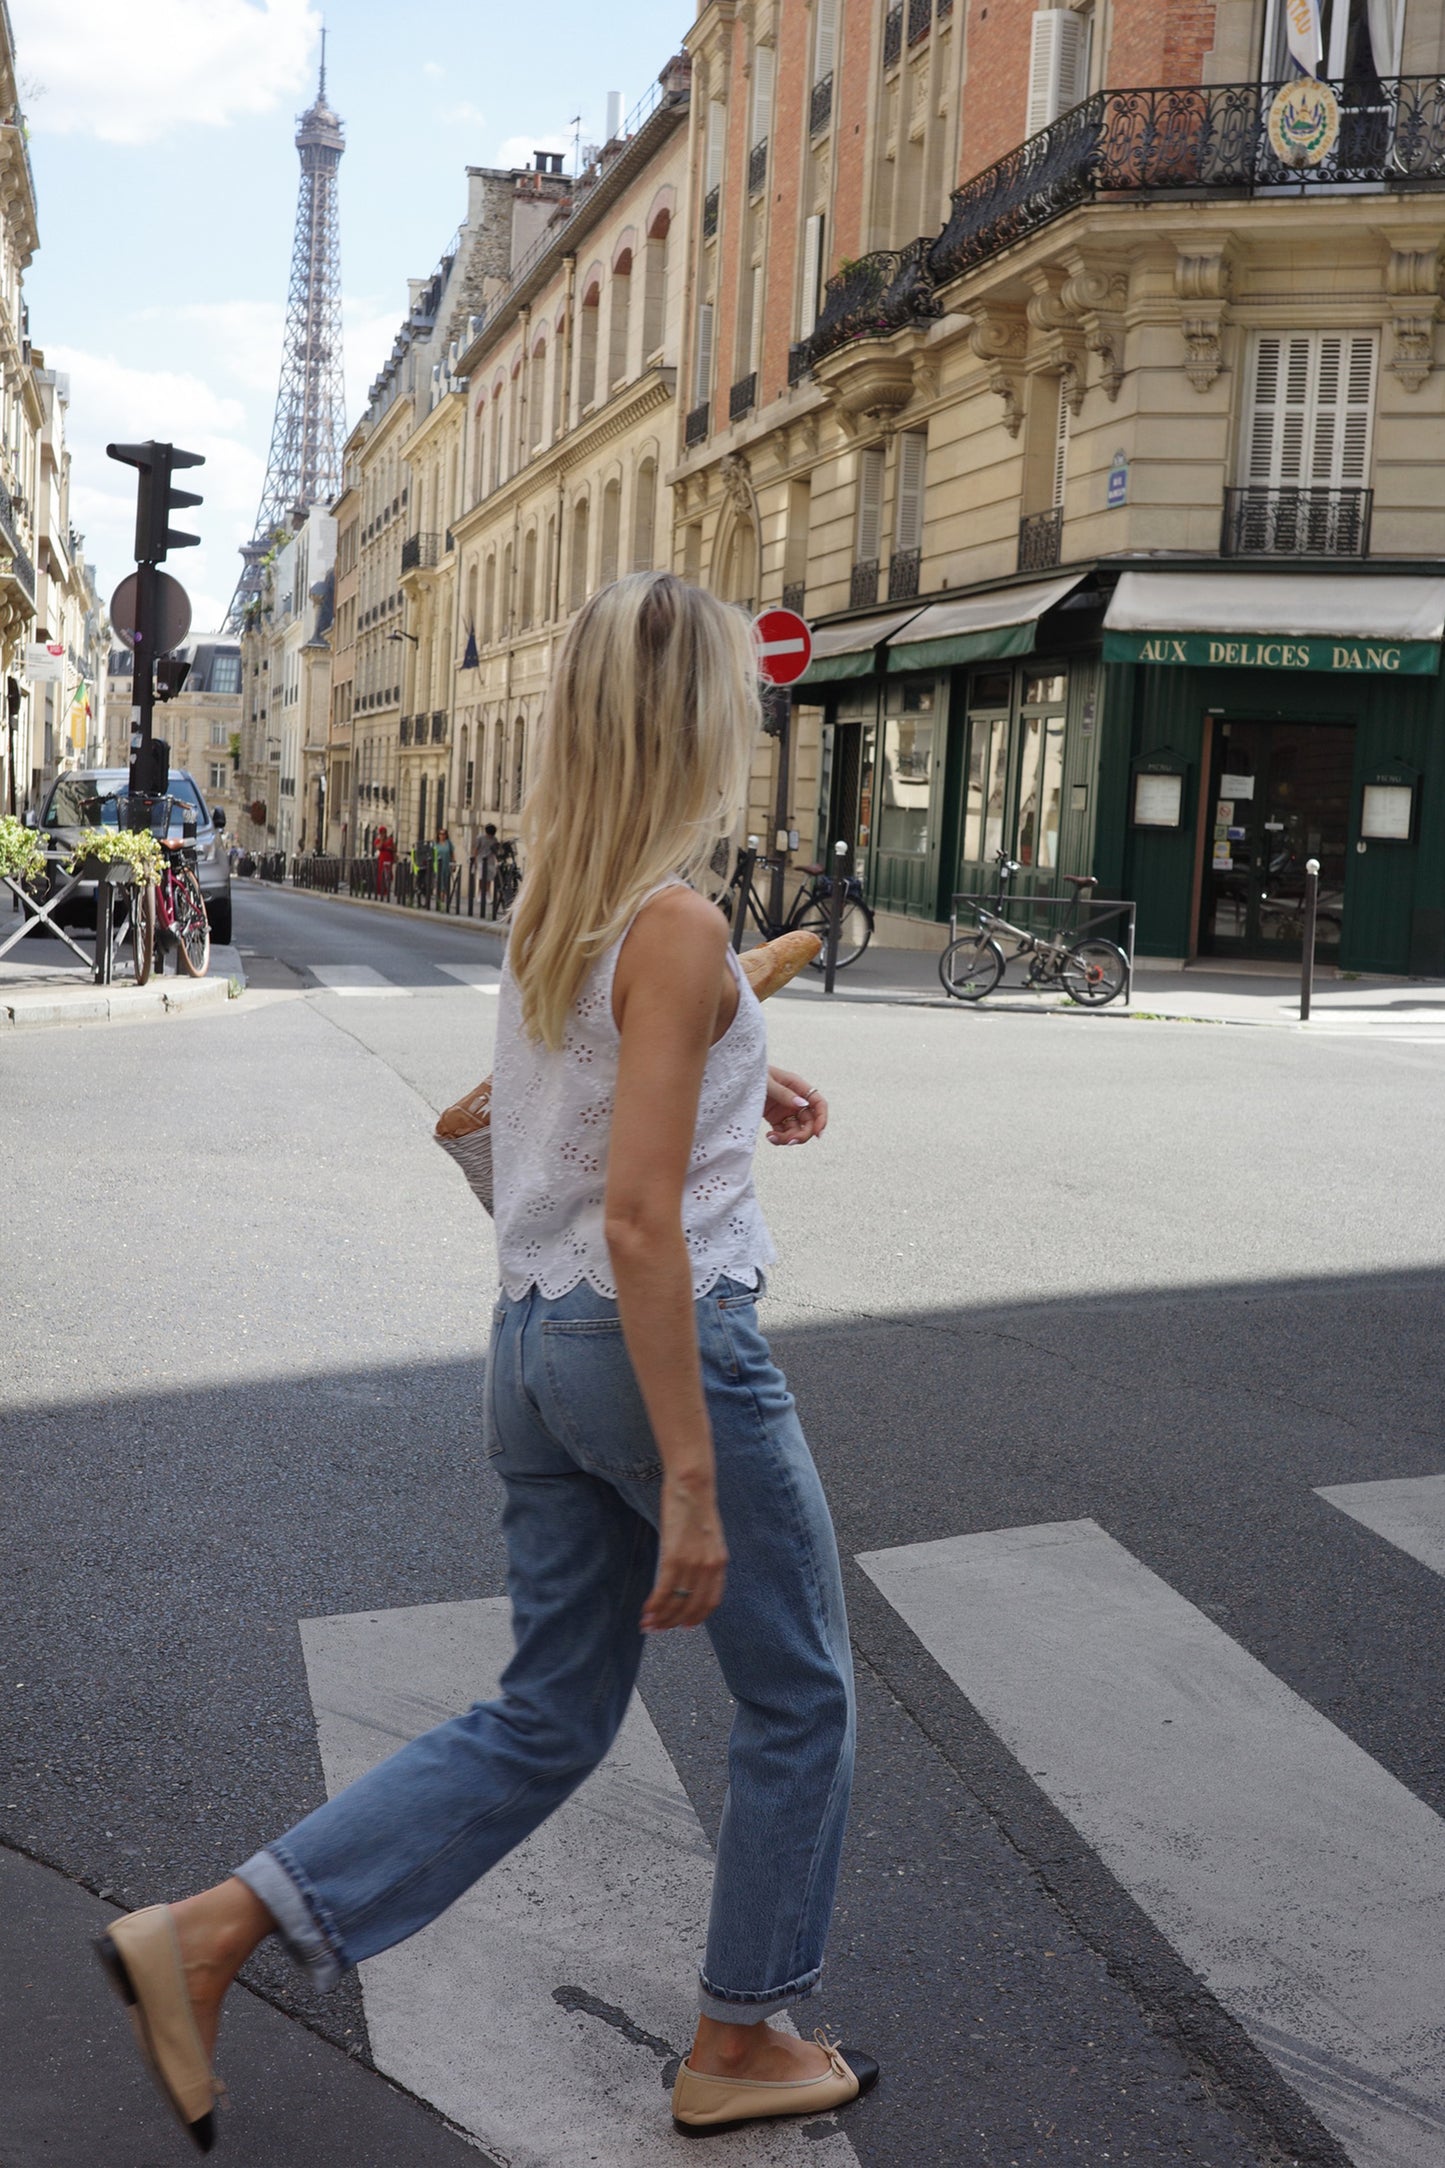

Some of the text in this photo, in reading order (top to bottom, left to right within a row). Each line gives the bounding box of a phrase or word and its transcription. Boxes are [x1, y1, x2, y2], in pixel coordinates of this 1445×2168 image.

[1139, 639, 1401, 671] AUX DELICES DANG
